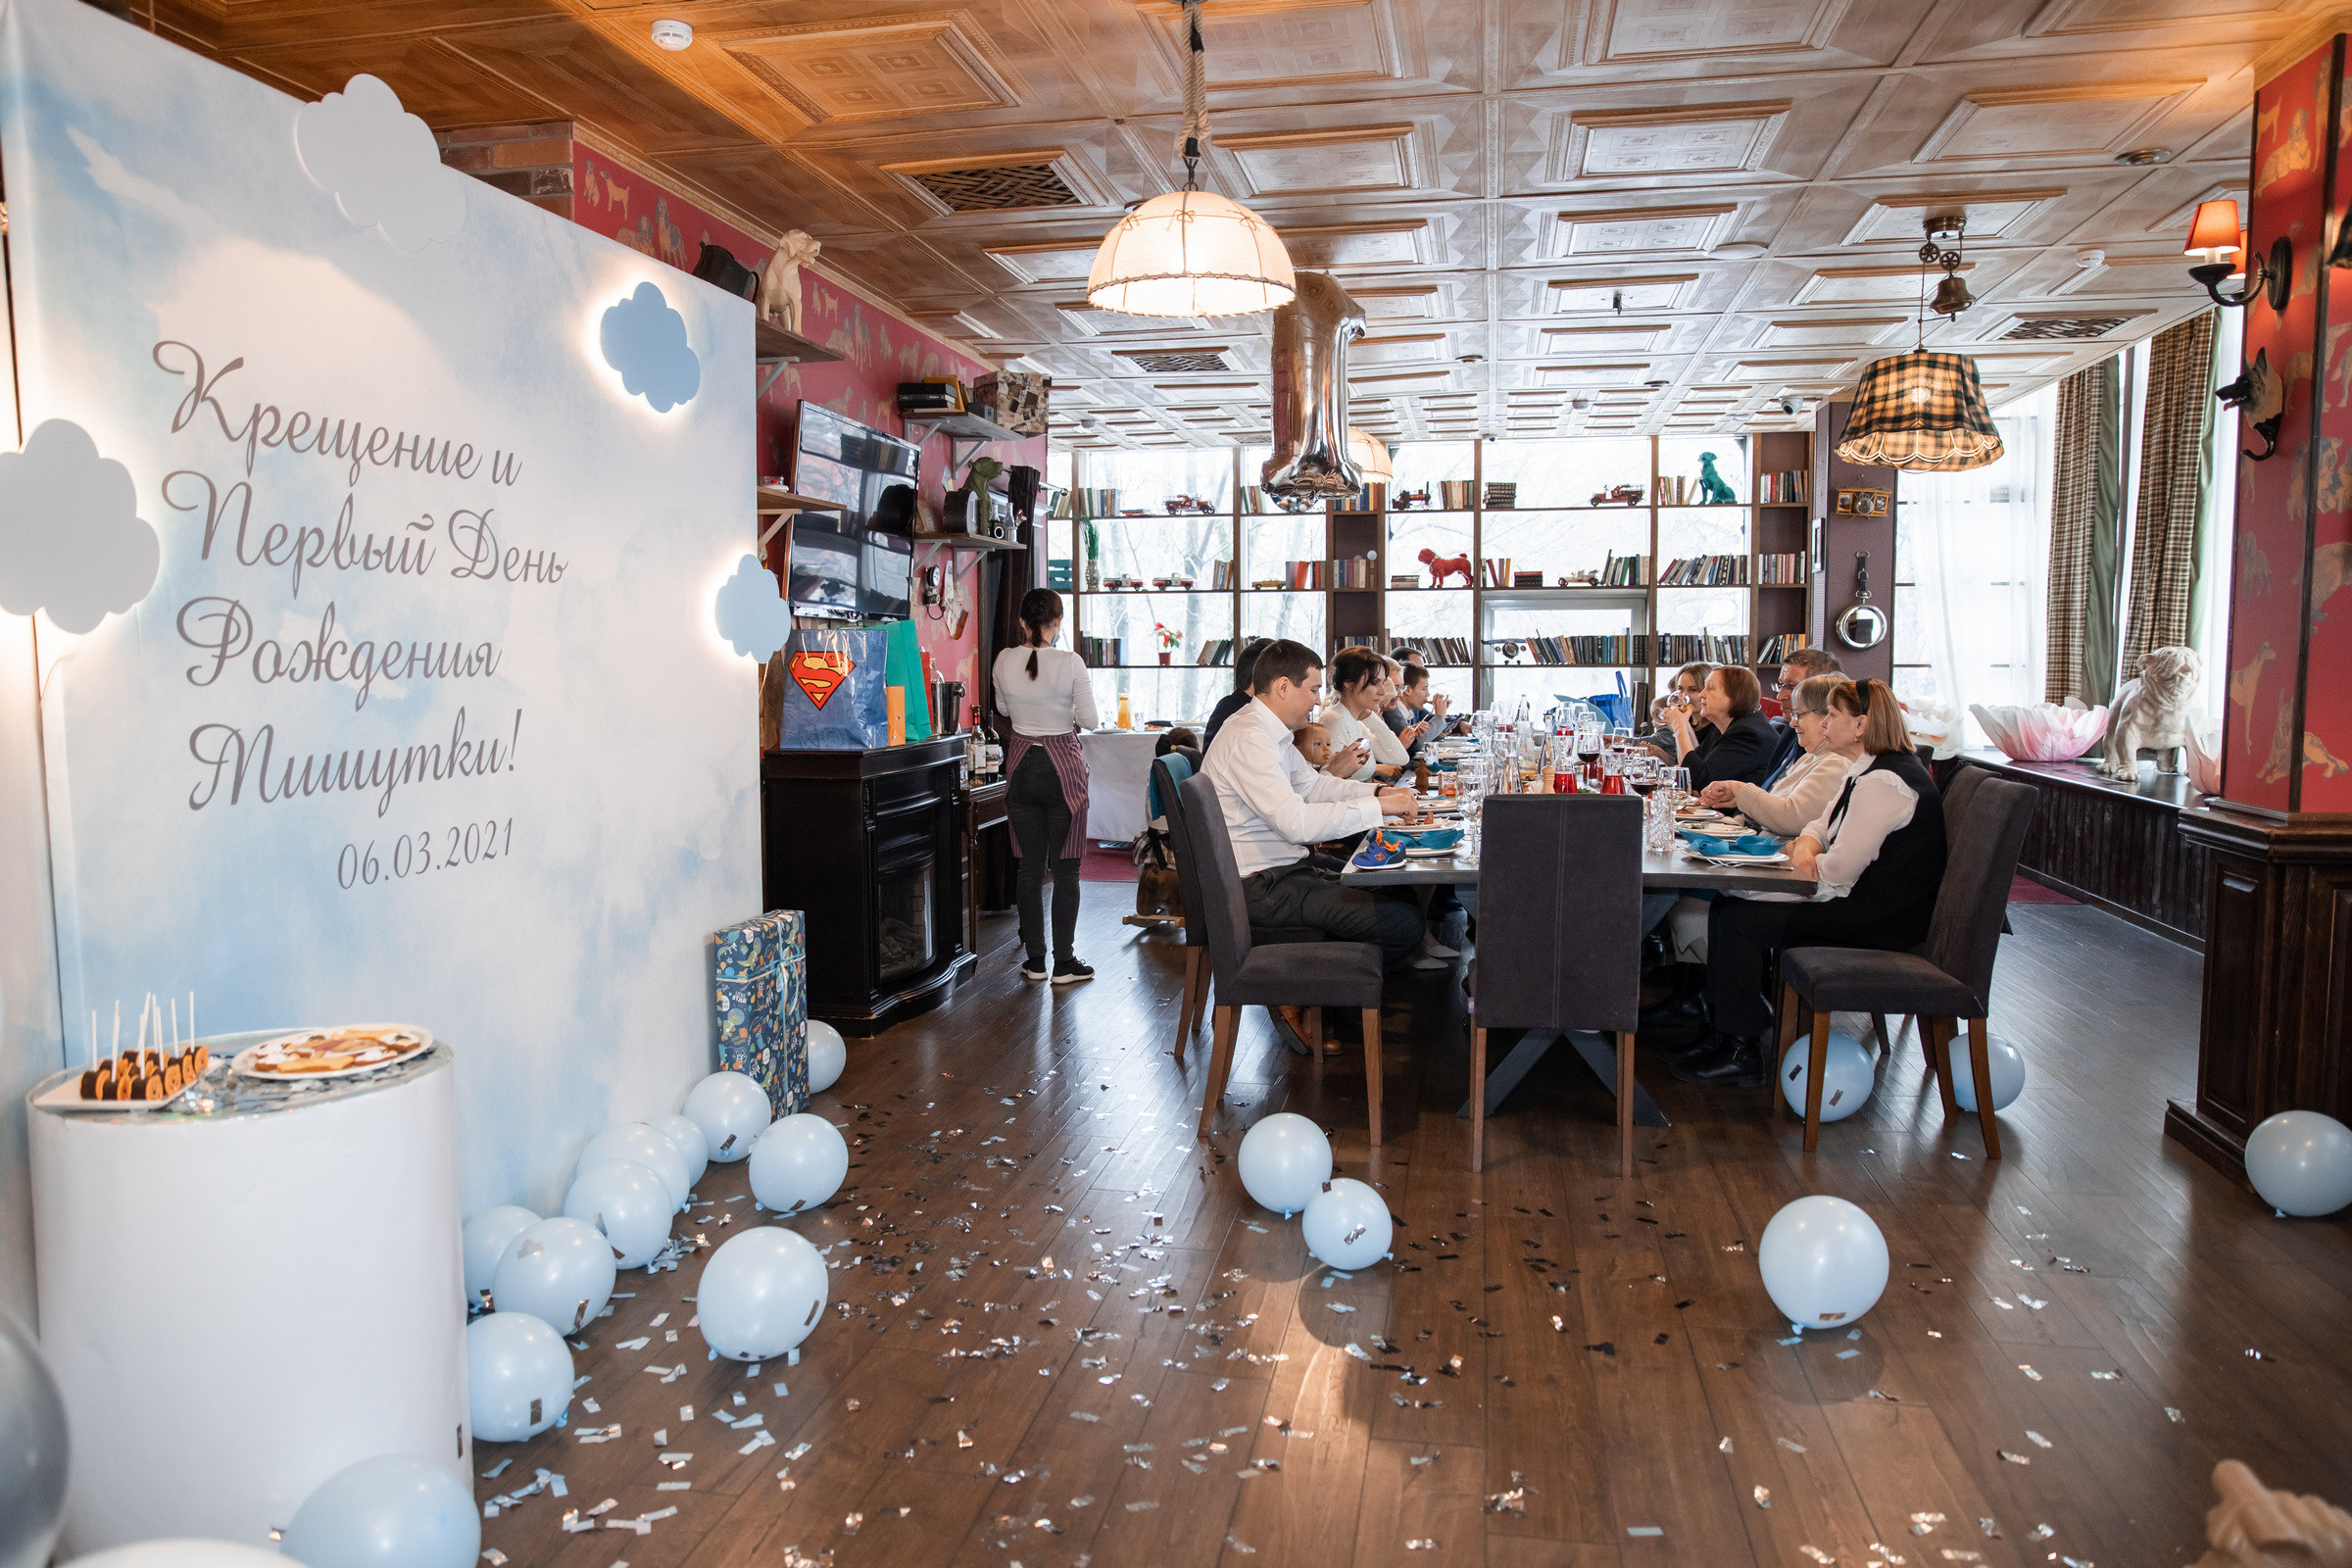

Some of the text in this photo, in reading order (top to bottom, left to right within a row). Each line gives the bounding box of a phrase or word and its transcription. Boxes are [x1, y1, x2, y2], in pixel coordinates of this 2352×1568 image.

[153, 340, 522, 487] Крещение и
[162, 470, 568, 600] Первый День
[176, 596, 503, 711] Рождения
[188, 706, 523, 818] Мишутки!
[337, 817, 514, 890] 06.03.2021
